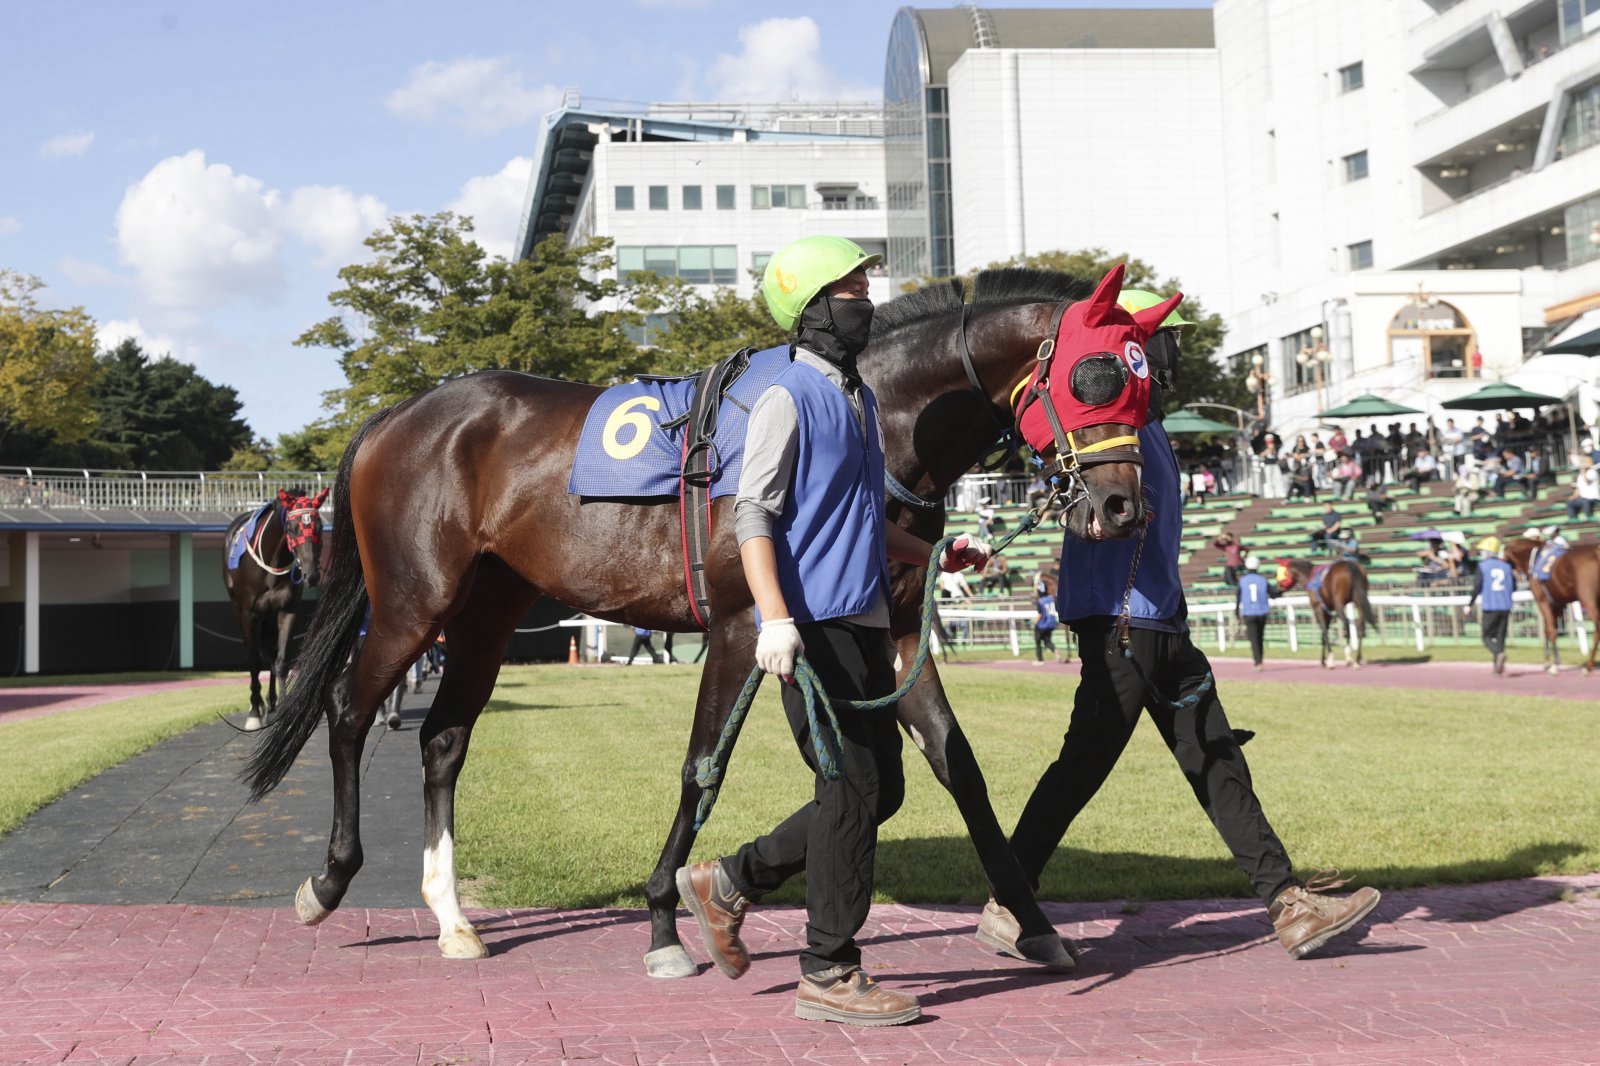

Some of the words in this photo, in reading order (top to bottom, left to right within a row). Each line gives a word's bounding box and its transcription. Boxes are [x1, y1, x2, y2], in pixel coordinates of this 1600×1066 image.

[602, 396, 661, 460] 6
[1490, 568, 1505, 591] 2
[1248, 583, 1258, 602] 1
